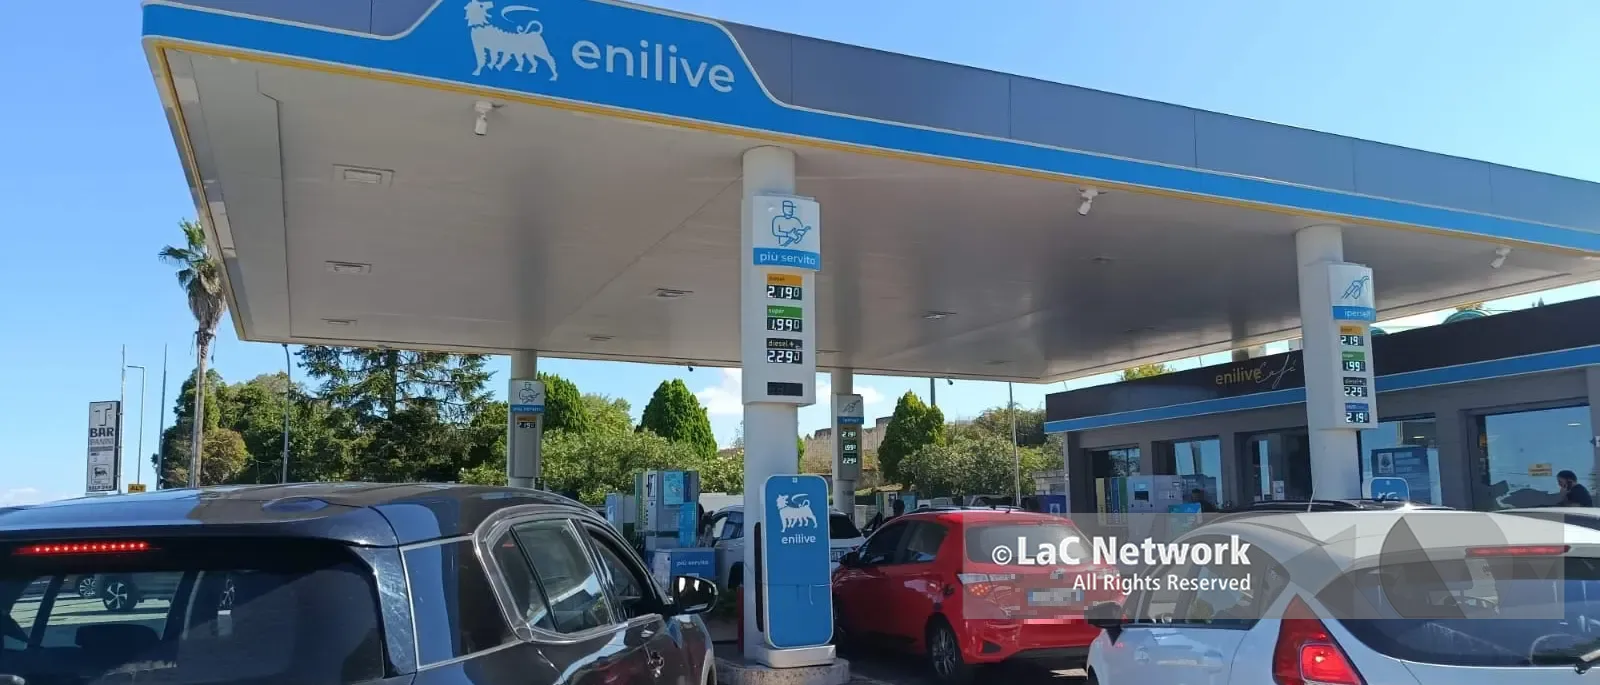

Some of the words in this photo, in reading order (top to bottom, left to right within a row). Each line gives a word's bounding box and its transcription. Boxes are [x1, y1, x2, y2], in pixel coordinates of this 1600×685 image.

[571, 39, 735, 93] enilive
[759, 251, 778, 264] più
[781, 254, 816, 265] servito
[1215, 367, 1262, 386] enilive
[90, 427, 114, 438] BAR
[781, 533, 817, 545] enilive
